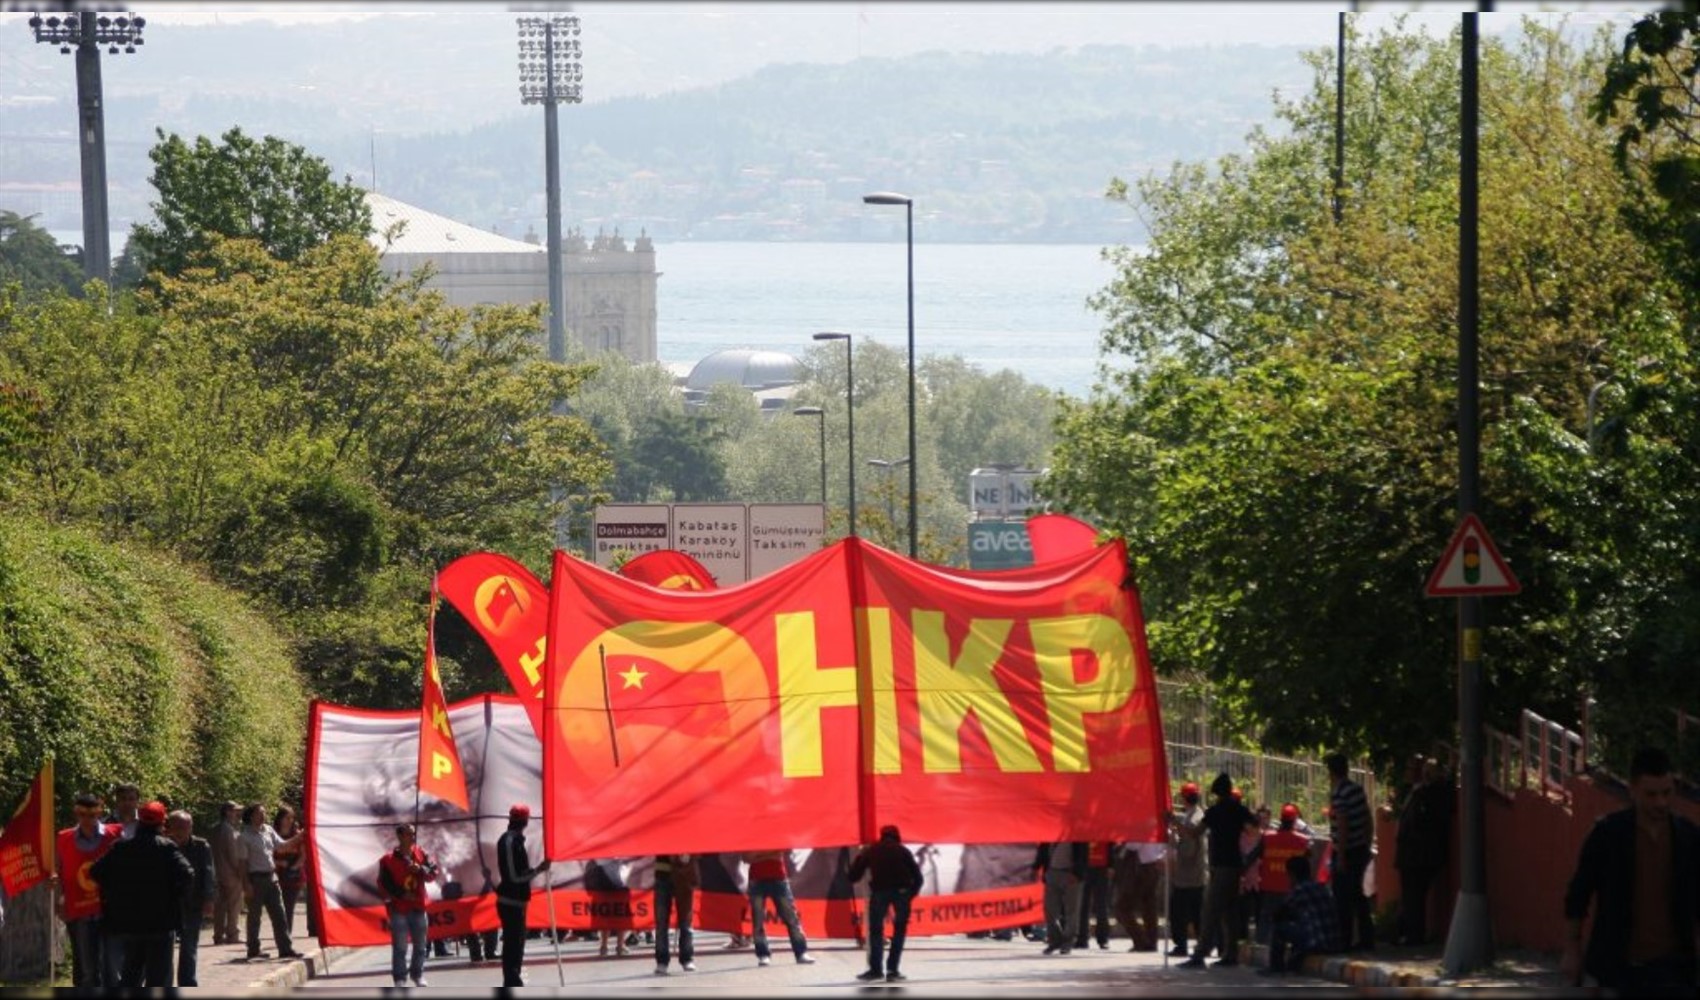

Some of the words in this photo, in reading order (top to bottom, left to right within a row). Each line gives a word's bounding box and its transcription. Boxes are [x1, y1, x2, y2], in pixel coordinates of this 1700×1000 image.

[753, 539, 806, 549] Taksim
[973, 530, 1032, 551] avea
[775, 606, 1137, 778] HKP
[571, 901, 648, 917] ENGELS
